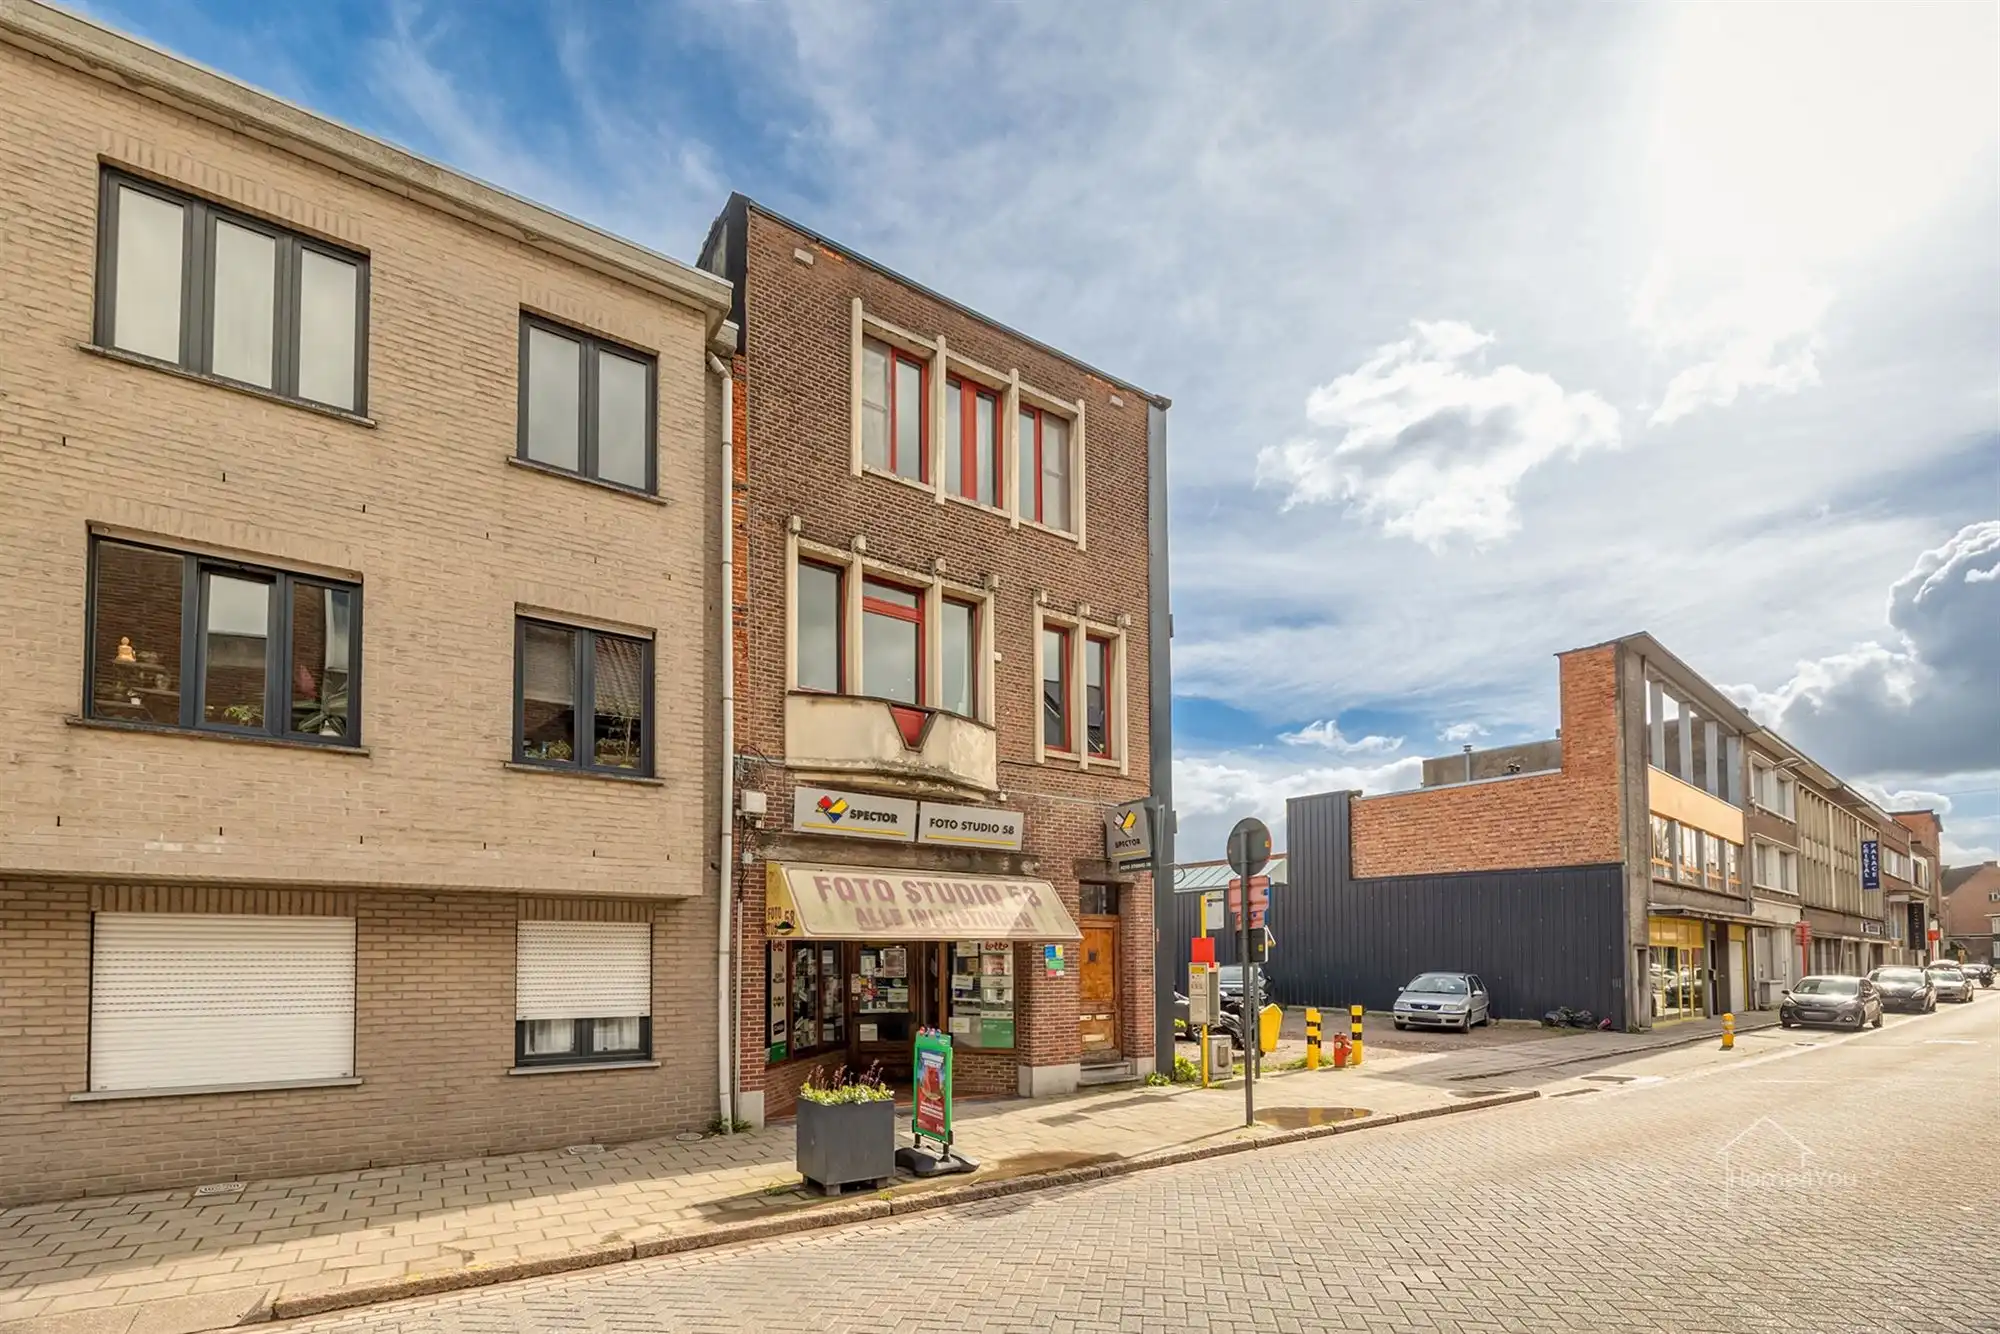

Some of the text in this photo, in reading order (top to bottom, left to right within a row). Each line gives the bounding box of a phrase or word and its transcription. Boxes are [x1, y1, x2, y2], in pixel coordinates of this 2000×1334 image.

[850, 808, 898, 824] SPECTOR
[929, 817, 1015, 836] FOTO STUDIO 58
[1115, 838, 1141, 848] SPECTOR
[1870, 843, 1878, 878] PALACE
[813, 876, 1042, 909] FOTO STUDIO 58
[855, 907, 904, 927] ALLE
